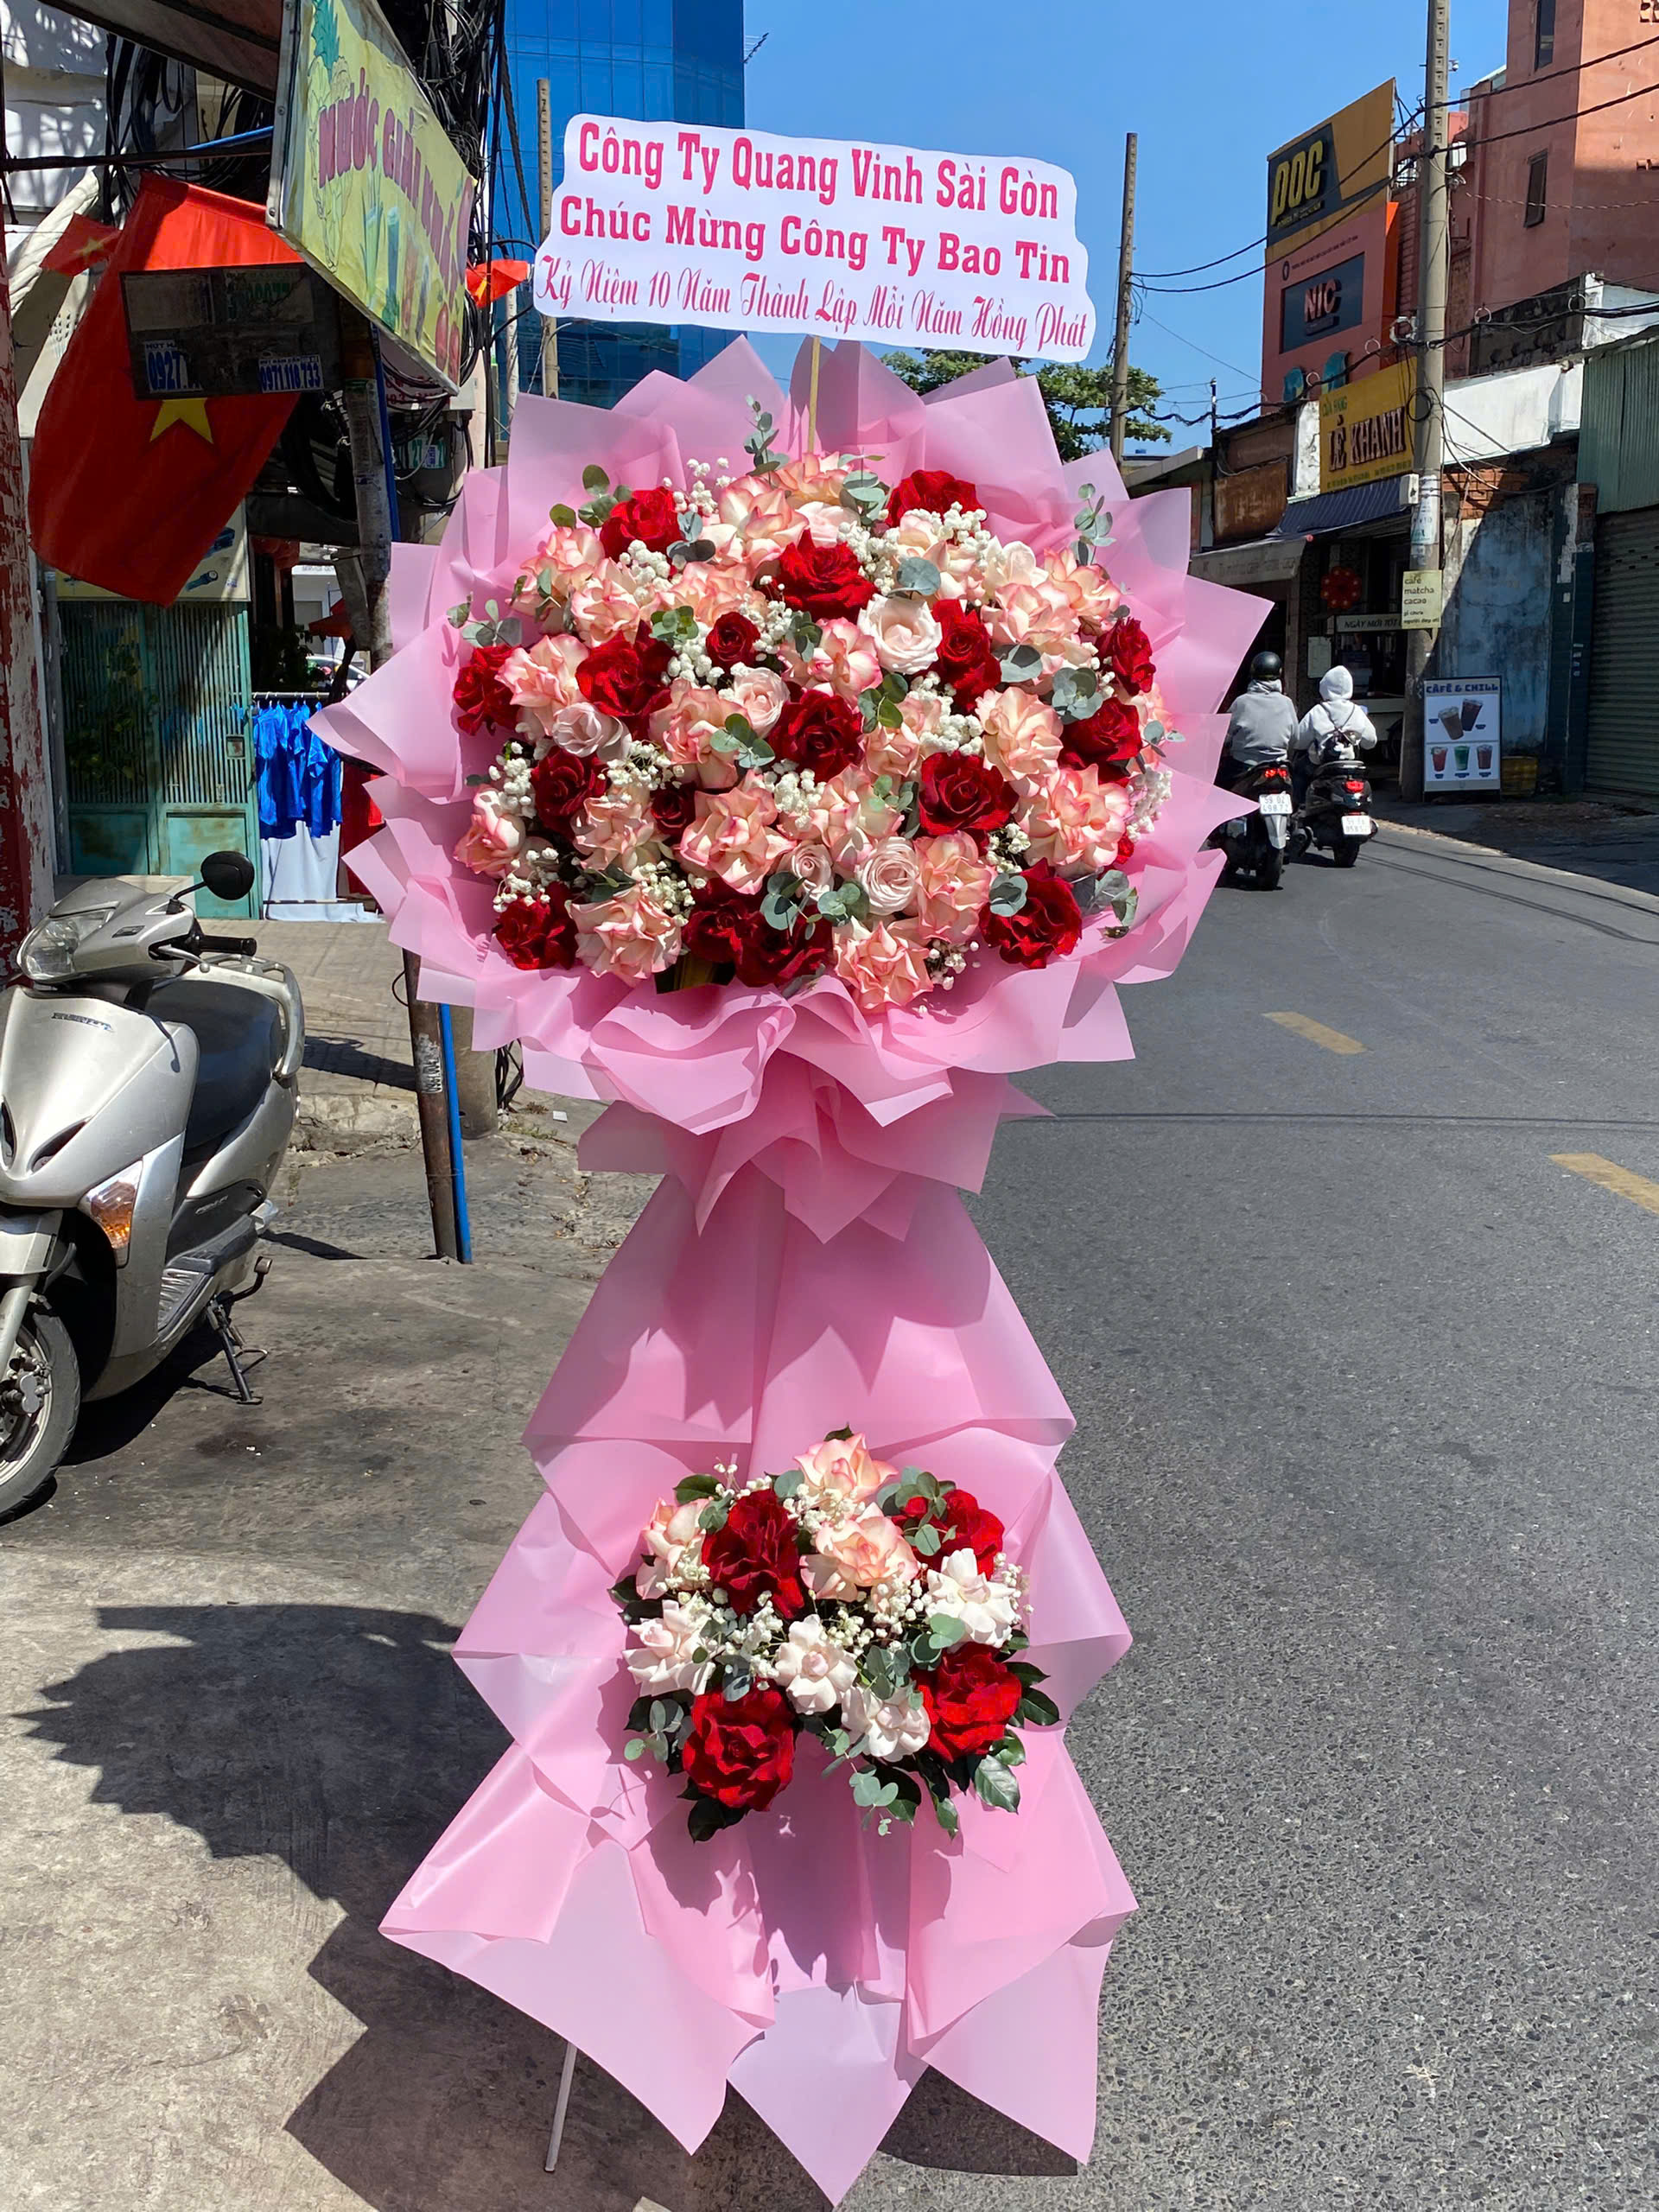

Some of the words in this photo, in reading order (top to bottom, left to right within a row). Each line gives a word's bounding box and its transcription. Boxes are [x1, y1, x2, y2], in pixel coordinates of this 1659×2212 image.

[579, 122, 664, 189] Công
[677, 131, 720, 194] Ty
[733, 137, 838, 205] Quang
[851, 148, 923, 204] Vinh
[937, 159, 986, 211] Sài
[1000, 166, 1058, 219] Gòn
[561, 195, 651, 241] Chúc
[665, 204, 766, 261] Mừng
[780, 215, 868, 270] Công
[882, 226, 925, 276] Ty
[938, 232, 1001, 276] Bao
[1015, 240, 1070, 283] Tin
[536, 255, 572, 310] Kỷ
[581, 258, 639, 314] Niệm
[648, 270, 671, 309] 10
[677, 267, 731, 314] Năm
[741, 272, 809, 320] Thành
[815, 279, 857, 334] Lập
[863, 284, 905, 330] Mỗi
[911, 289, 963, 335] Năm
[971, 296, 1029, 352] Hồng
[1035, 302, 1087, 353] Phát
[1404, 587, 1434, 595] matcha
[1465, 683, 1498, 692] CHILL
